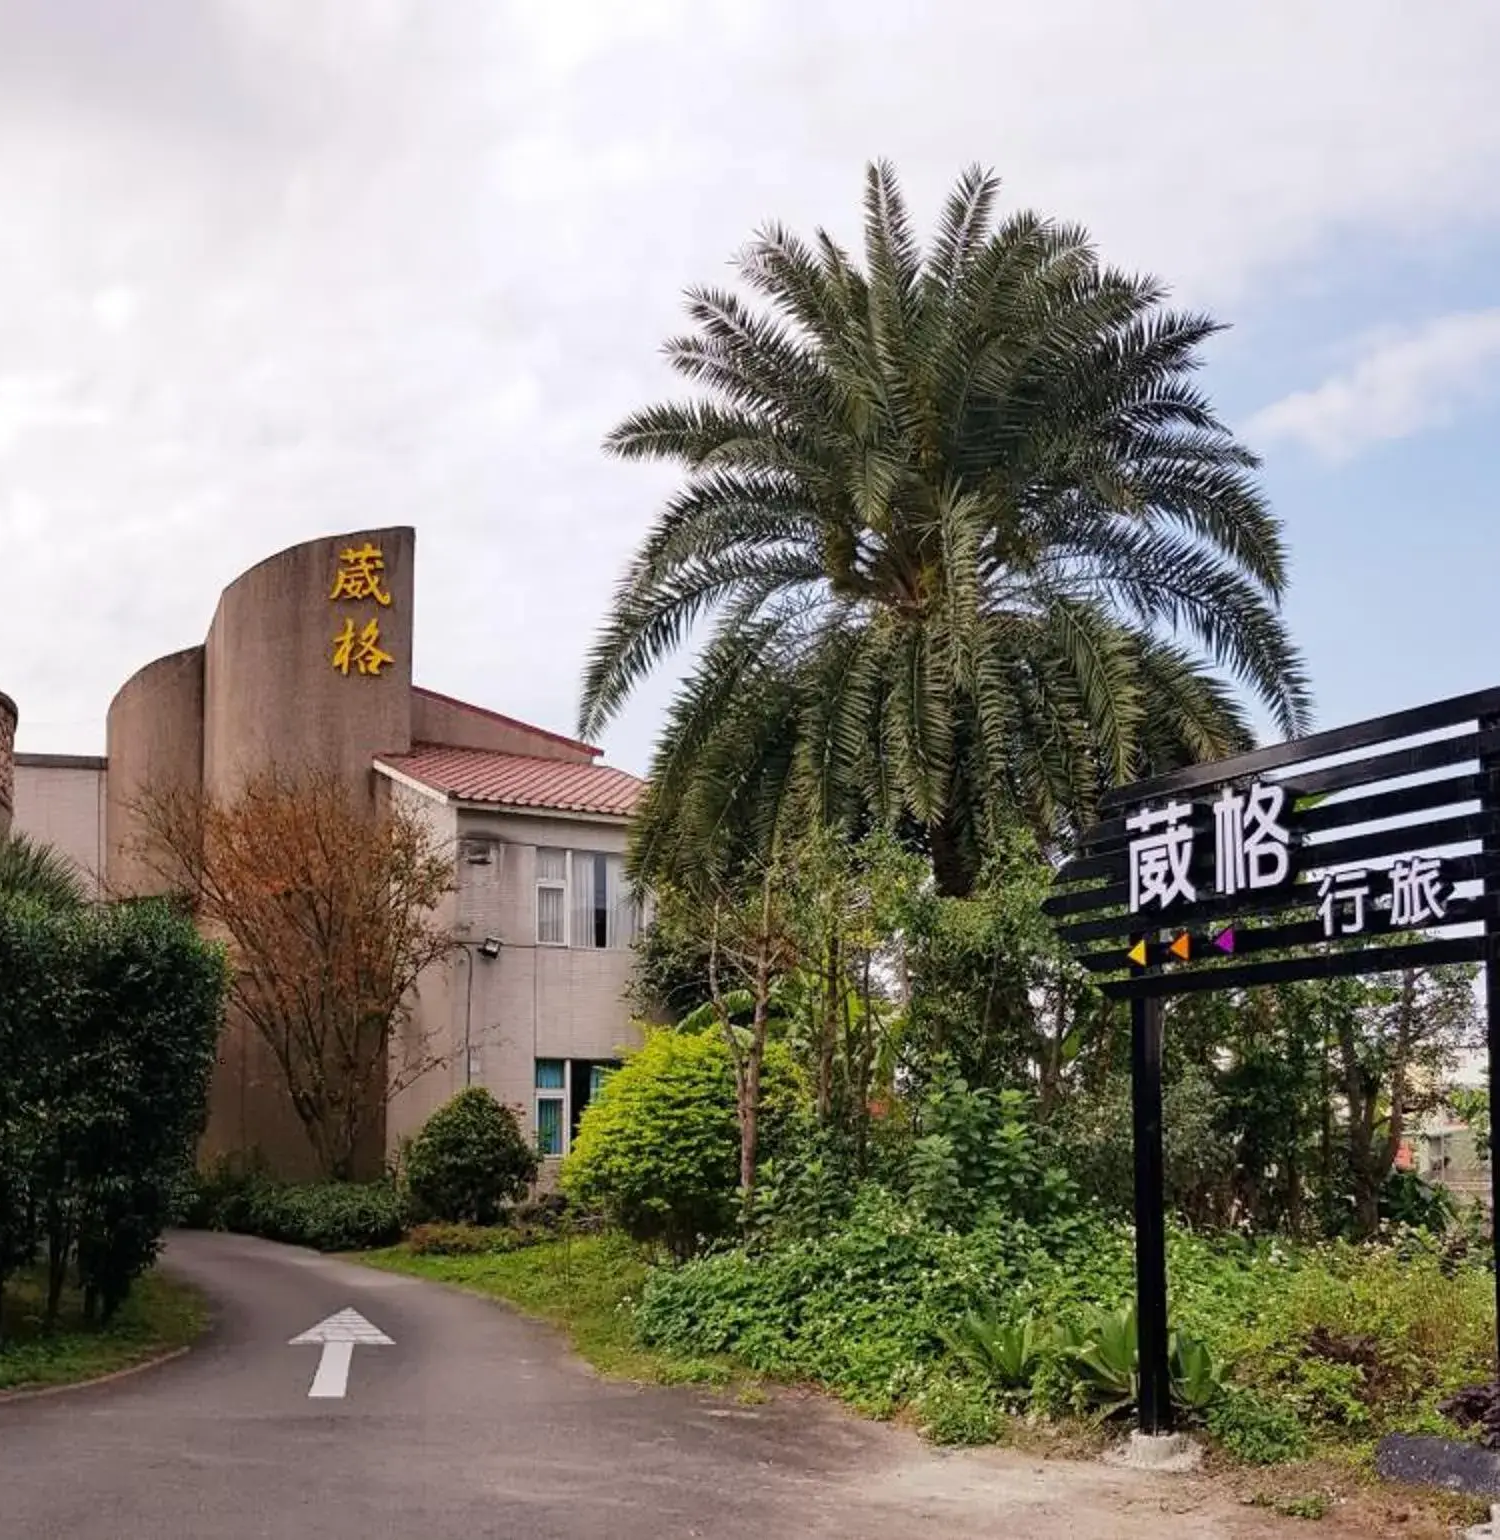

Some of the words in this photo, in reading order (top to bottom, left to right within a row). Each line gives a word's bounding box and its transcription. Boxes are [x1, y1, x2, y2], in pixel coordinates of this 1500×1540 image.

[329, 543, 396, 676] 葳格
[1125, 782, 1290, 913] 葳格
[1317, 856, 1445, 936] 行旅
